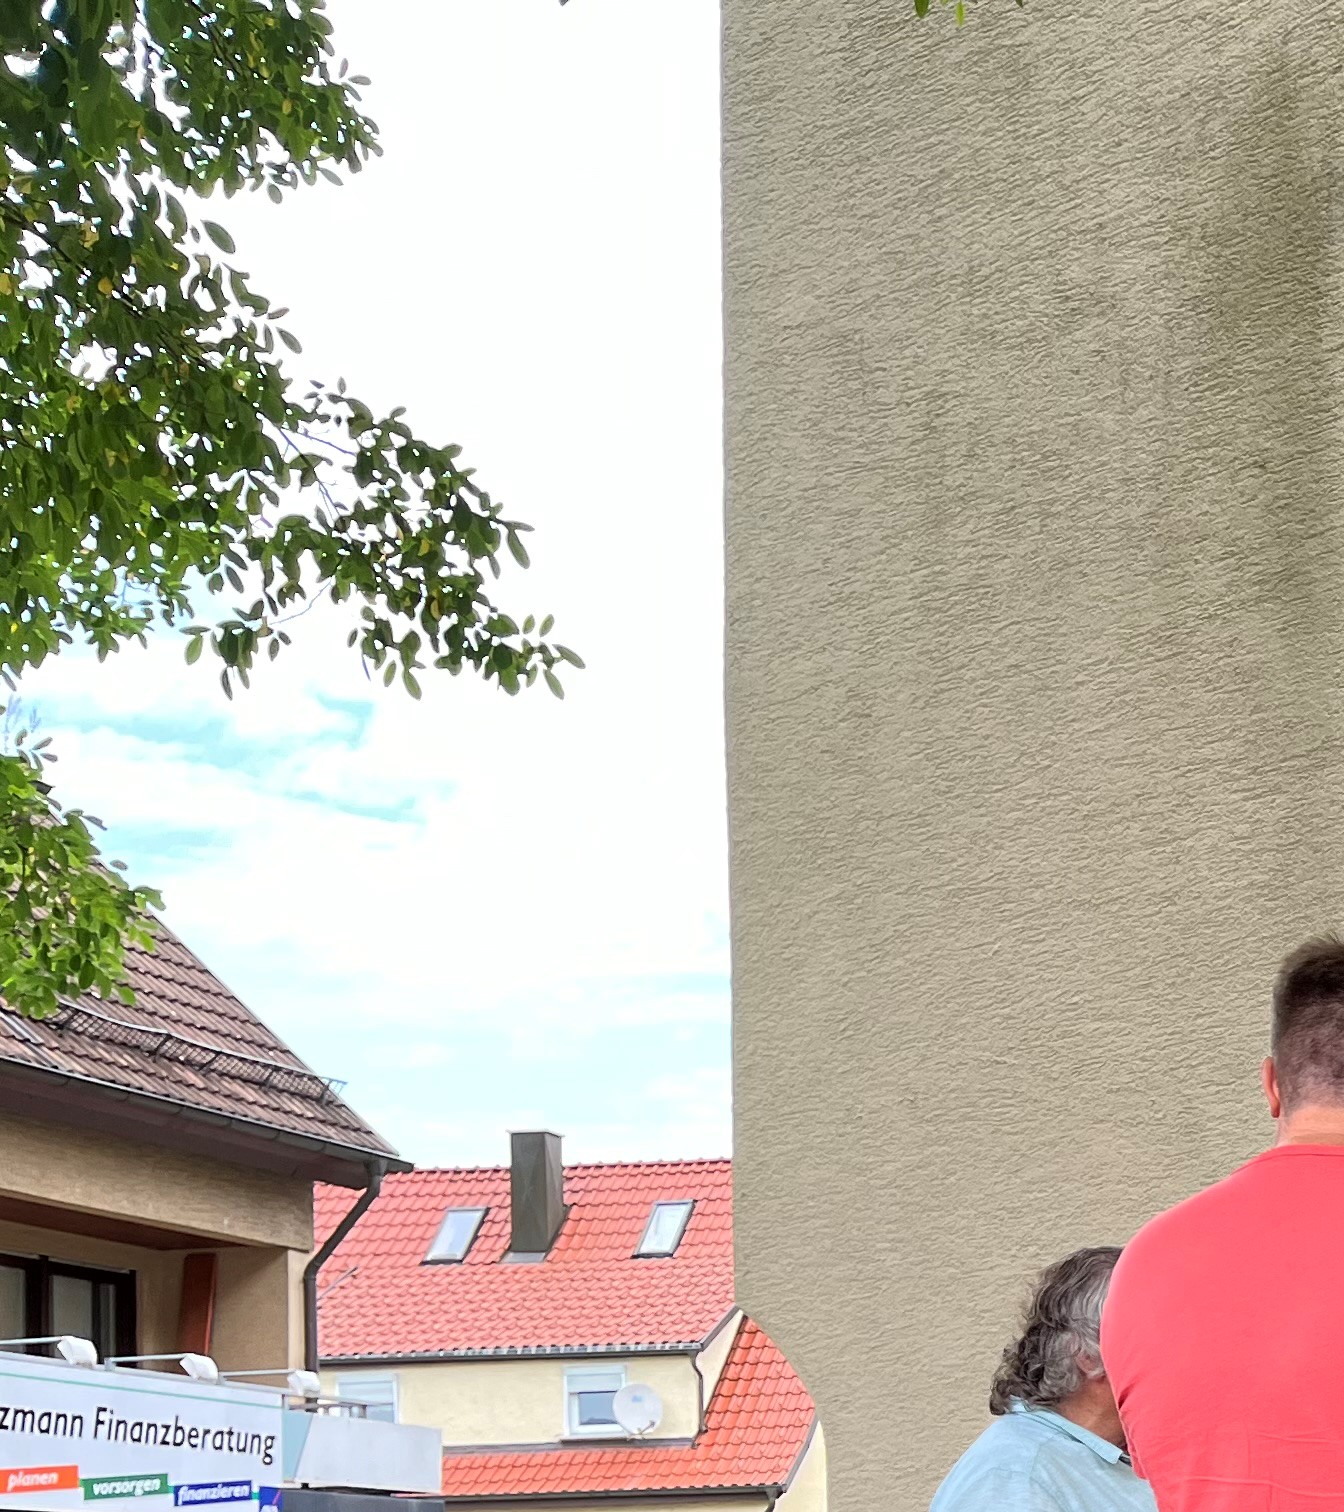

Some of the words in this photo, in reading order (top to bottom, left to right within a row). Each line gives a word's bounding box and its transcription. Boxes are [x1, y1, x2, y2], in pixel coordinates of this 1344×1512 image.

[0, 1406, 83, 1438] zmann
[94, 1406, 275, 1466] Finanzberatung
[7, 1471, 59, 1492] planen
[92, 1478, 161, 1497] vorsorgen
[177, 1483, 251, 1506] finanzieren
